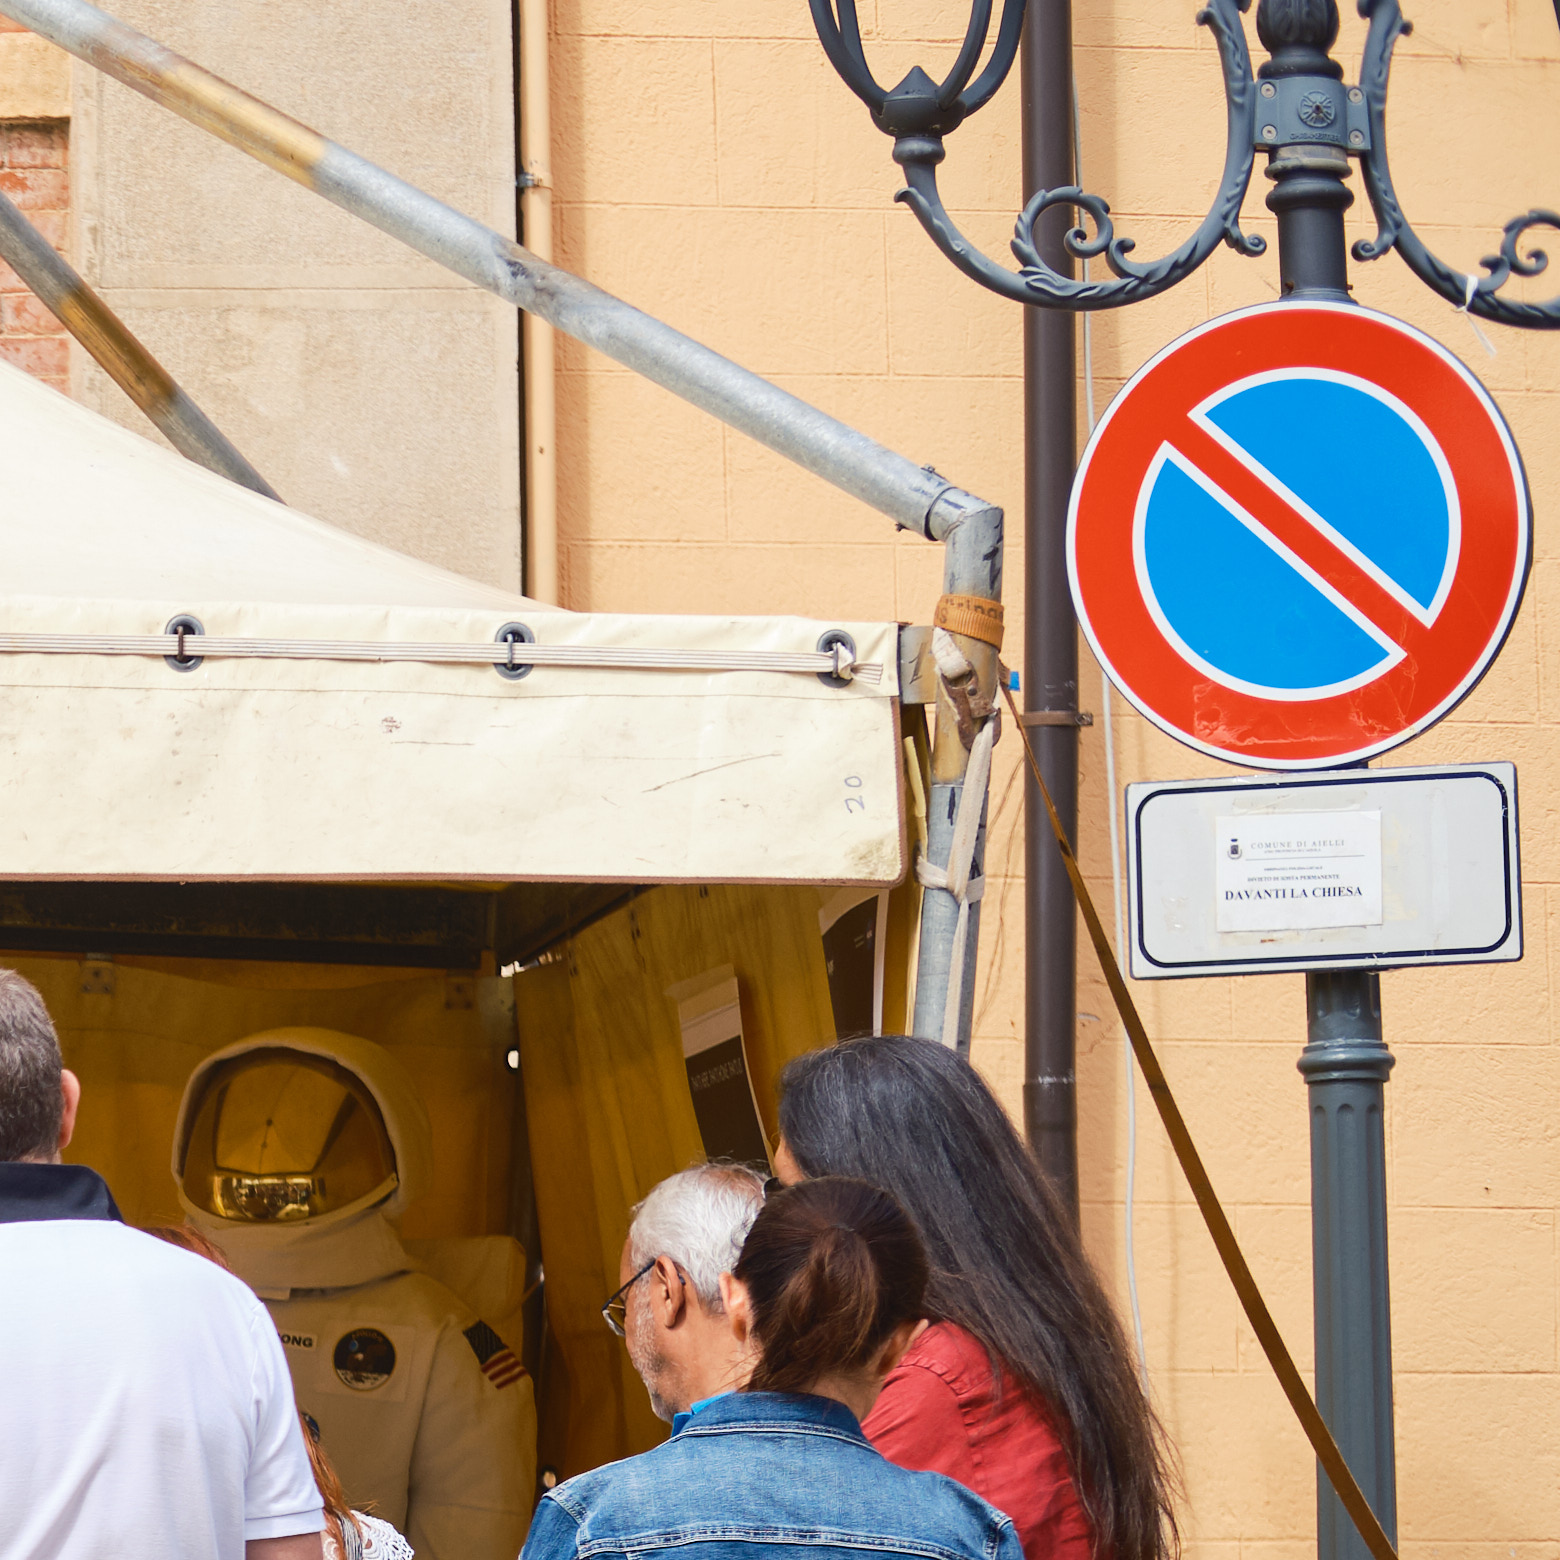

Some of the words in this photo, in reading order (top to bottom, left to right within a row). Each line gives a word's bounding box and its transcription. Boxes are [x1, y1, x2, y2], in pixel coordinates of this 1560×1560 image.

[1225, 888, 1287, 901] DAVANTI
[1290, 888, 1308, 899] LA
[1312, 886, 1363, 898] CHIESA
[278, 1333, 313, 1348] ONG
